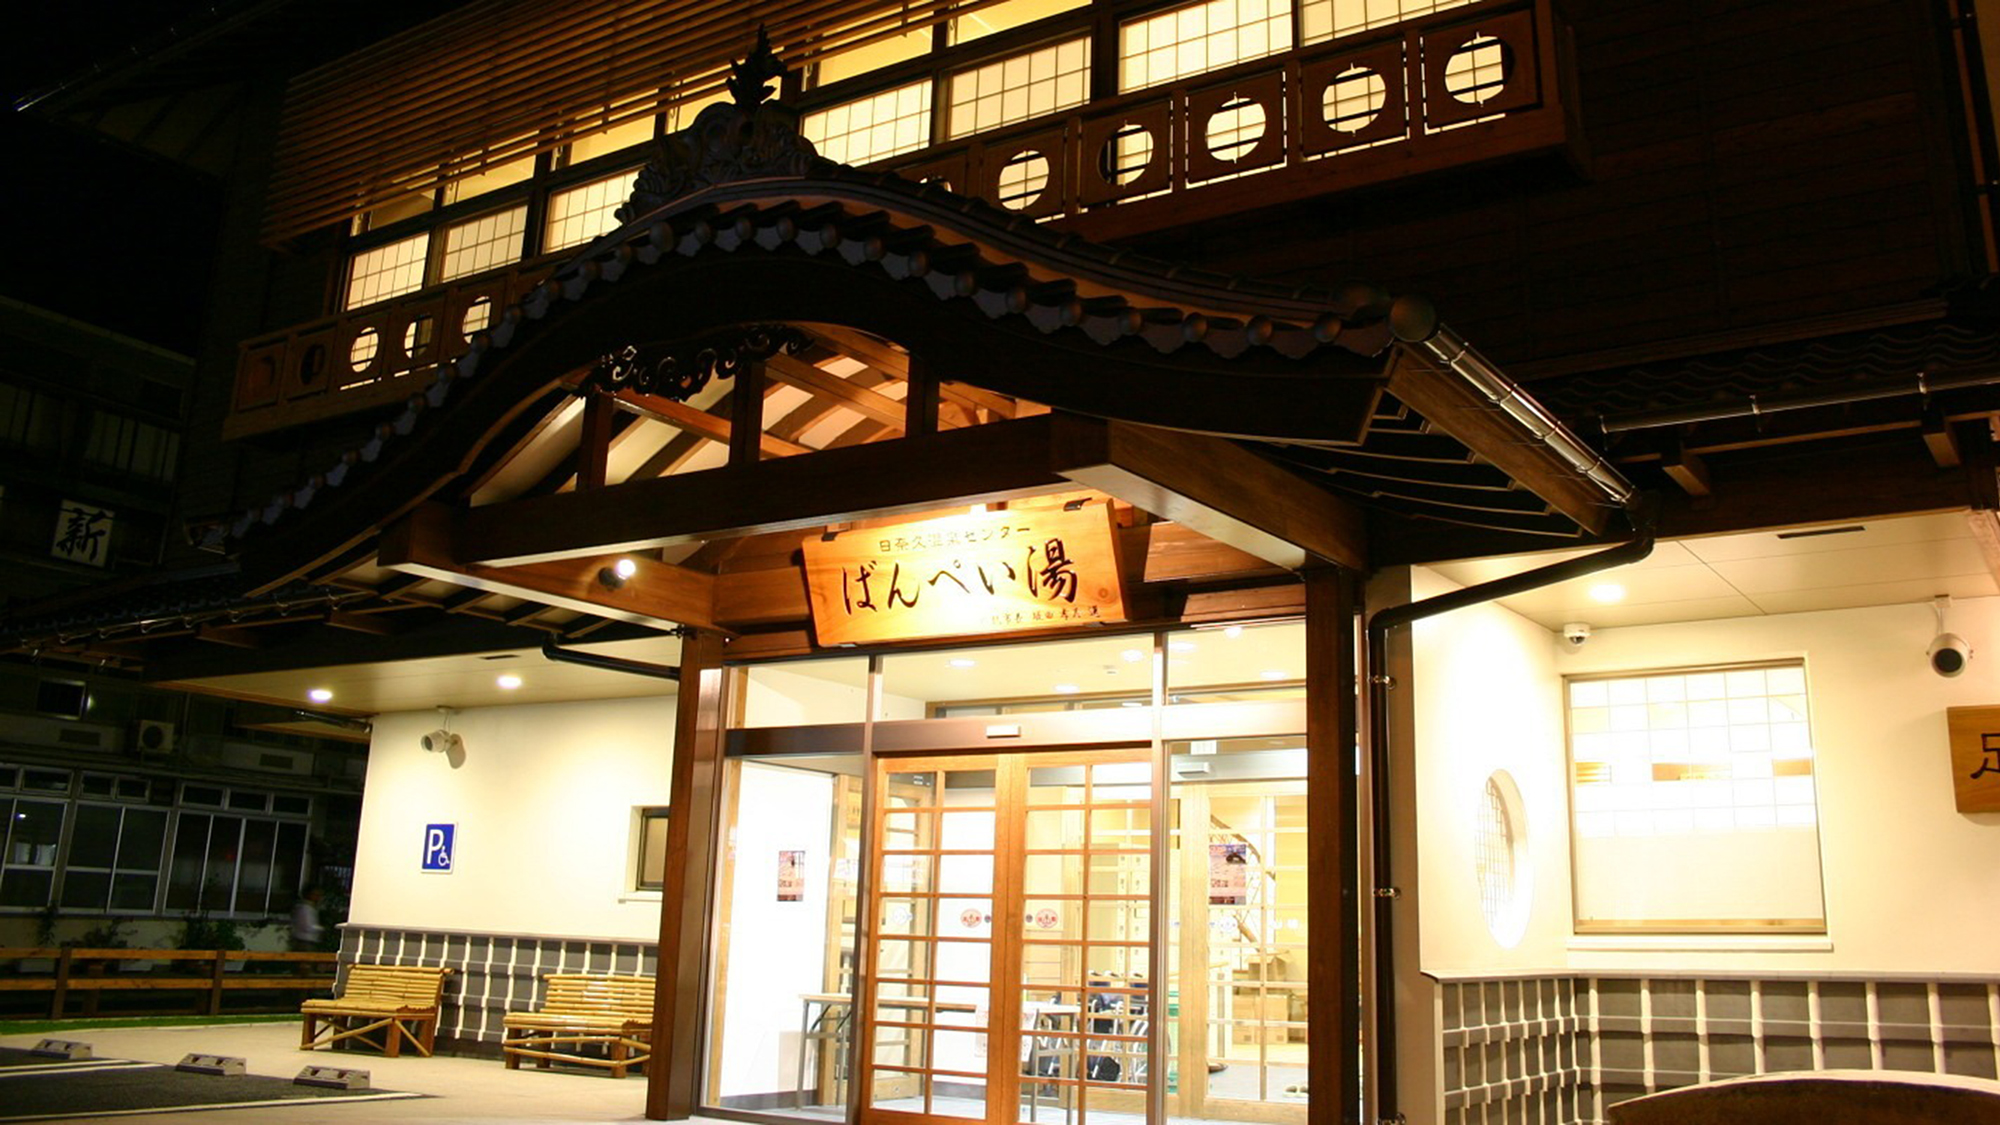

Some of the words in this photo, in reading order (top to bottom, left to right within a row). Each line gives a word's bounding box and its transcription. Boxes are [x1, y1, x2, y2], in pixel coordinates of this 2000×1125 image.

[56, 507, 106, 562] 新
[842, 538, 1078, 616] ばんぺい湯
[427, 829, 444, 864] P
